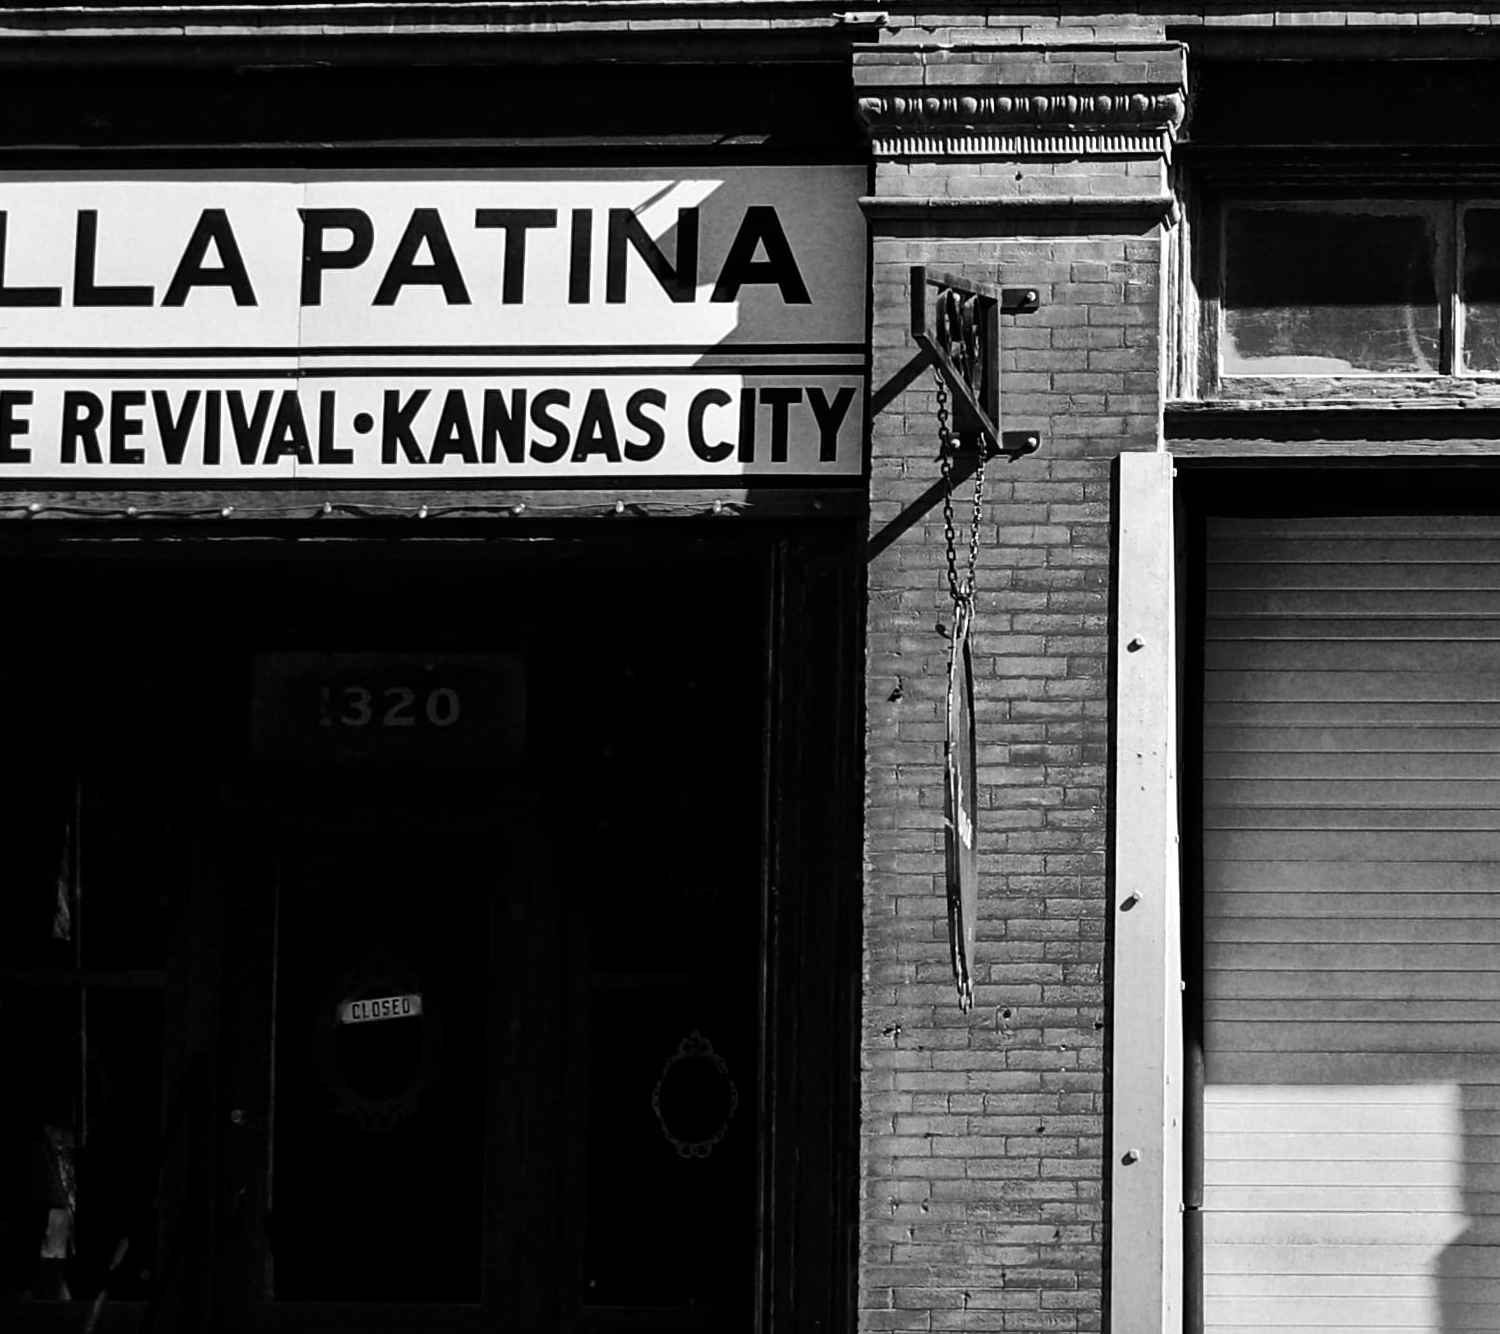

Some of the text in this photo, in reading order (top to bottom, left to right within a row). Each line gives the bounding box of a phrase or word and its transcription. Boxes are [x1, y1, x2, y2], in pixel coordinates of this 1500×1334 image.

[298, 204, 812, 308] PATINA
[687, 386, 857, 463] CITY
[351, 997, 411, 1020] CLOSED
